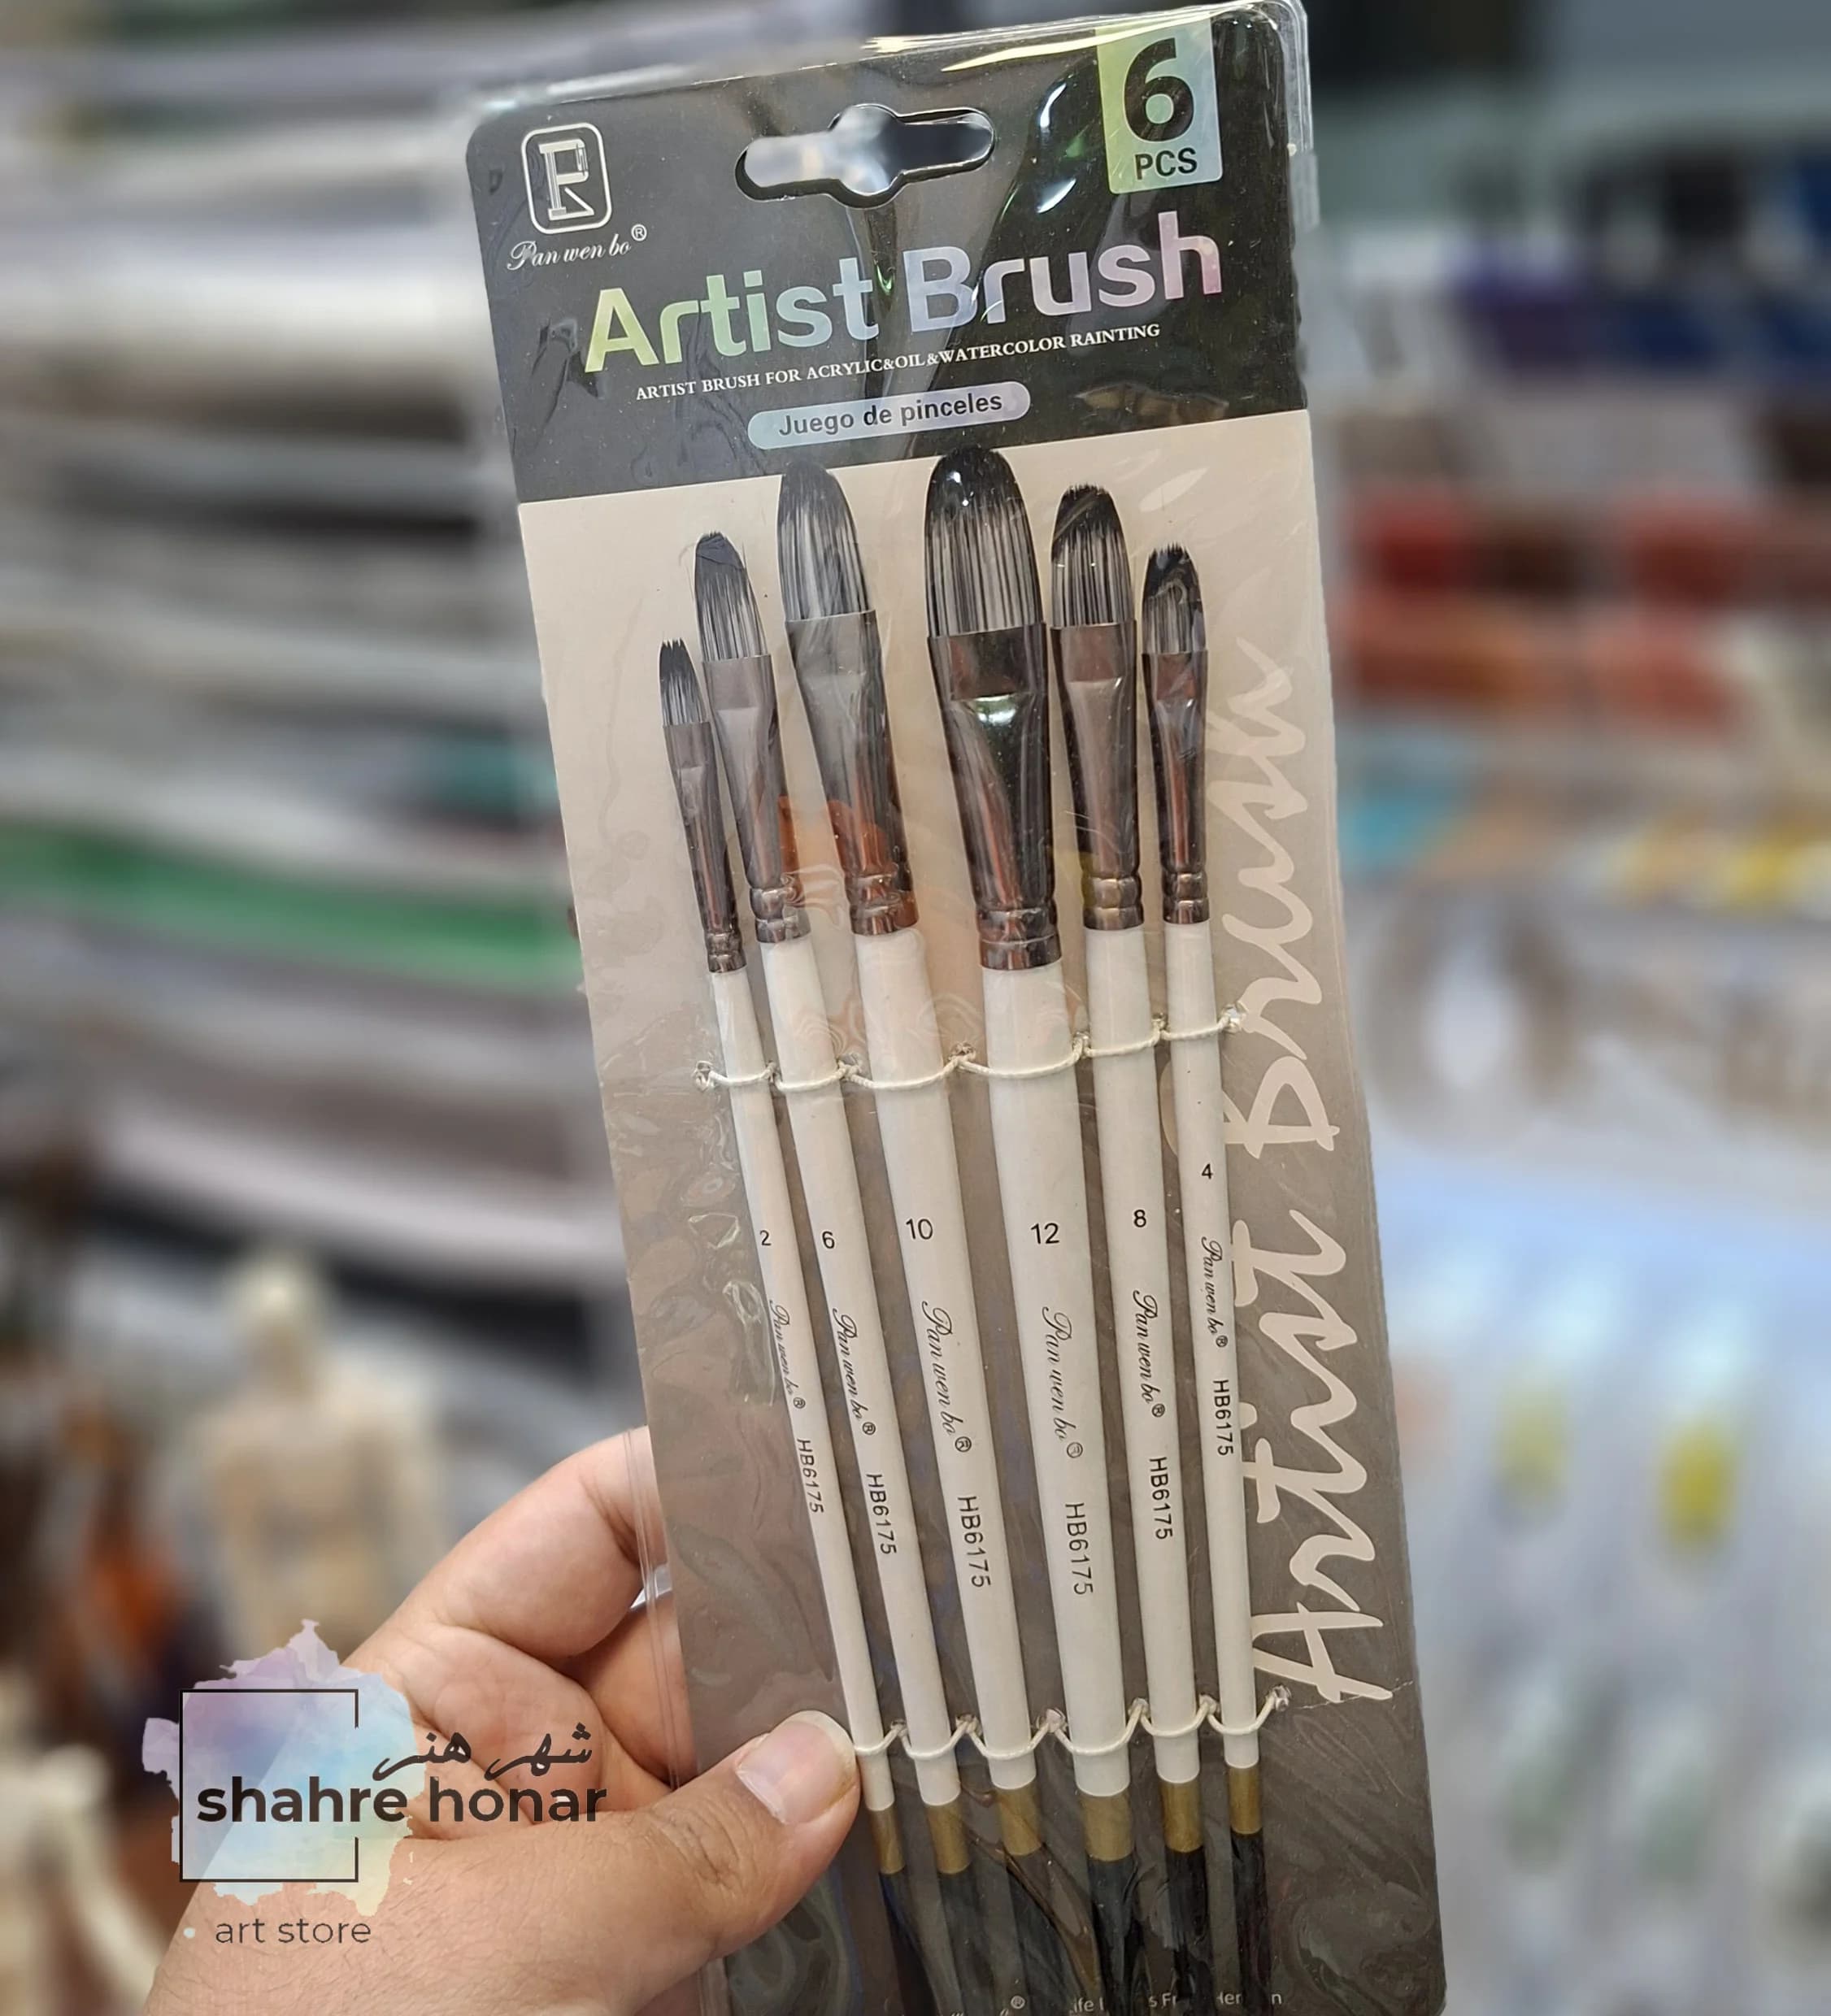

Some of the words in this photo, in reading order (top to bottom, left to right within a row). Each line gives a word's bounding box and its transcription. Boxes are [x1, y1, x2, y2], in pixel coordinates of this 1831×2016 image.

[1124, 37, 1194, 142] 6
[1134, 147, 1198, 180] PCS
[507, 241, 560, 271] Pan
[563, 243, 606, 263] wen
[584, 256, 880, 374] Artist
[902, 211, 1222, 333] Brush
[636, 380, 696, 401] ARTIST
[702, 373, 760, 393] BRUSH
[765, 369, 802, 385] FOR
[1070, 324, 1161, 347] RAINTING
[778, 411, 855, 437] Juego
[863, 405, 892, 426] de
[900, 393, 1002, 427] pinceles
[1201, 1163, 1214, 1180] 4
[759, 1230, 772, 1246] 2
[822, 1231, 836, 1249] 6
[905, 1218, 934, 1241] 10
[1030, 1223, 1060, 1245] 12
[1133, 1210, 1147, 1227] 8
[1201, 1236, 1223, 1281] Pan
[1133, 1290, 1159, 1340] Pan
[1204, 1282, 1218, 1317] wen
[833, 1308, 858, 1358] Pan
[921, 1301, 953, 1361] Pan
[1042, 1306, 1072, 1364] Pan
[843, 1359, 858, 1397] wen
[1137, 1341, 1152, 1382] wen
[933, 1362, 950, 1407] wen
[1049, 1370, 1064, 1414] wen
[1213, 1379, 1233, 1456] HB6175
[794, 1438, 824, 1514] HB6175
[1150, 1457, 1172, 1540] HB6175
[867, 1473, 897, 1554] HB6175
[958, 1497, 991, 1588] HB6175
[1065, 1502, 1094, 1595] HB6175
